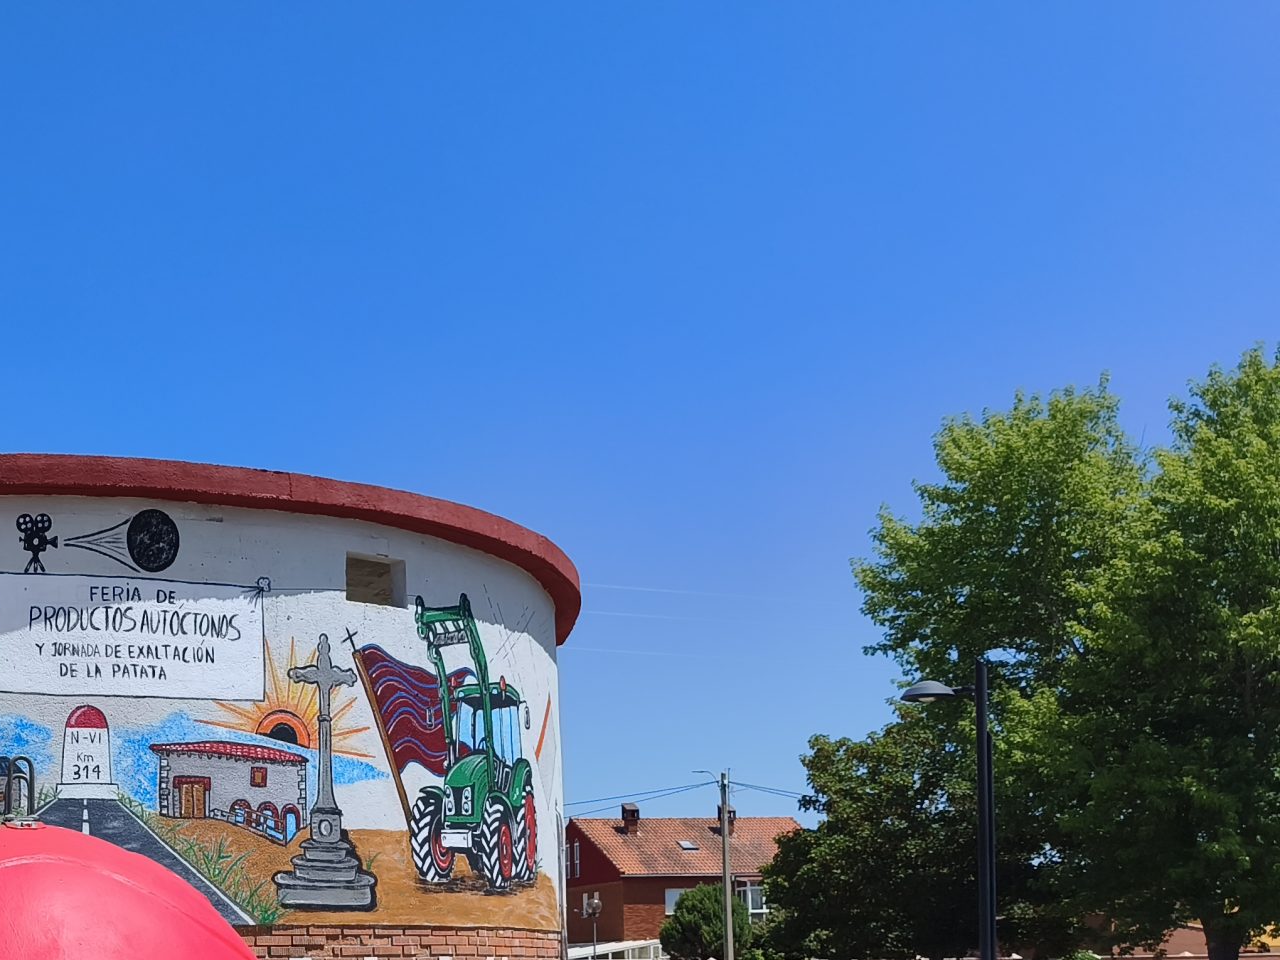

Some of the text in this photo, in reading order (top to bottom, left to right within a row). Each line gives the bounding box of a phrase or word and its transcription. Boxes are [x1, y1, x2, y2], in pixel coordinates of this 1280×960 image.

[89, 583, 176, 605] FERIA DE
[29, 603, 241, 642] PRODUCTOS AUTÓCTONOS
[35, 639, 215, 664] Y JORNADA DE EXALTACIÓN
[59, 662, 167, 680] DE LA PATATA
[73, 764, 101, 780] 314
